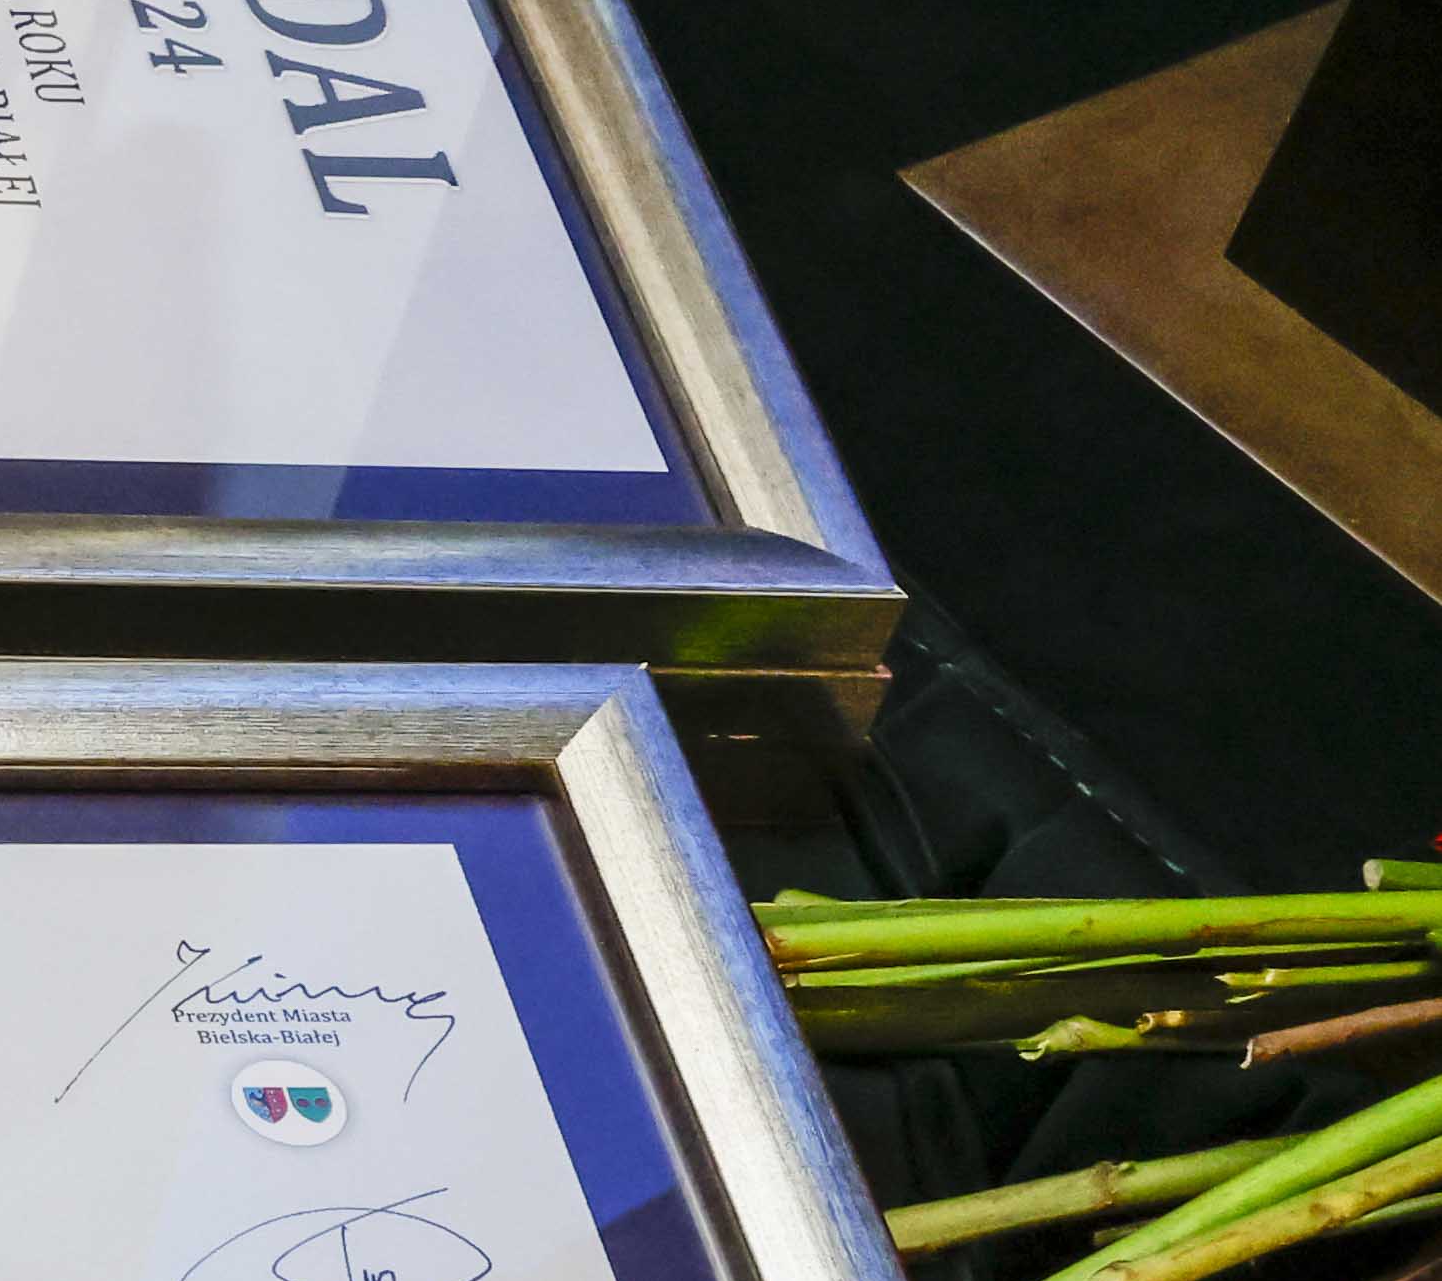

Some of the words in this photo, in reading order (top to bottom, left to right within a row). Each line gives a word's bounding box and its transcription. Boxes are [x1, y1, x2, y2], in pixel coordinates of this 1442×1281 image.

[9, 10, 85, 104] ROKU
[171, 1007, 278, 1027] Prezydent
[282, 1008, 352, 1023] Miasta
[196, 1029, 341, 1047] Bielska-Białej
